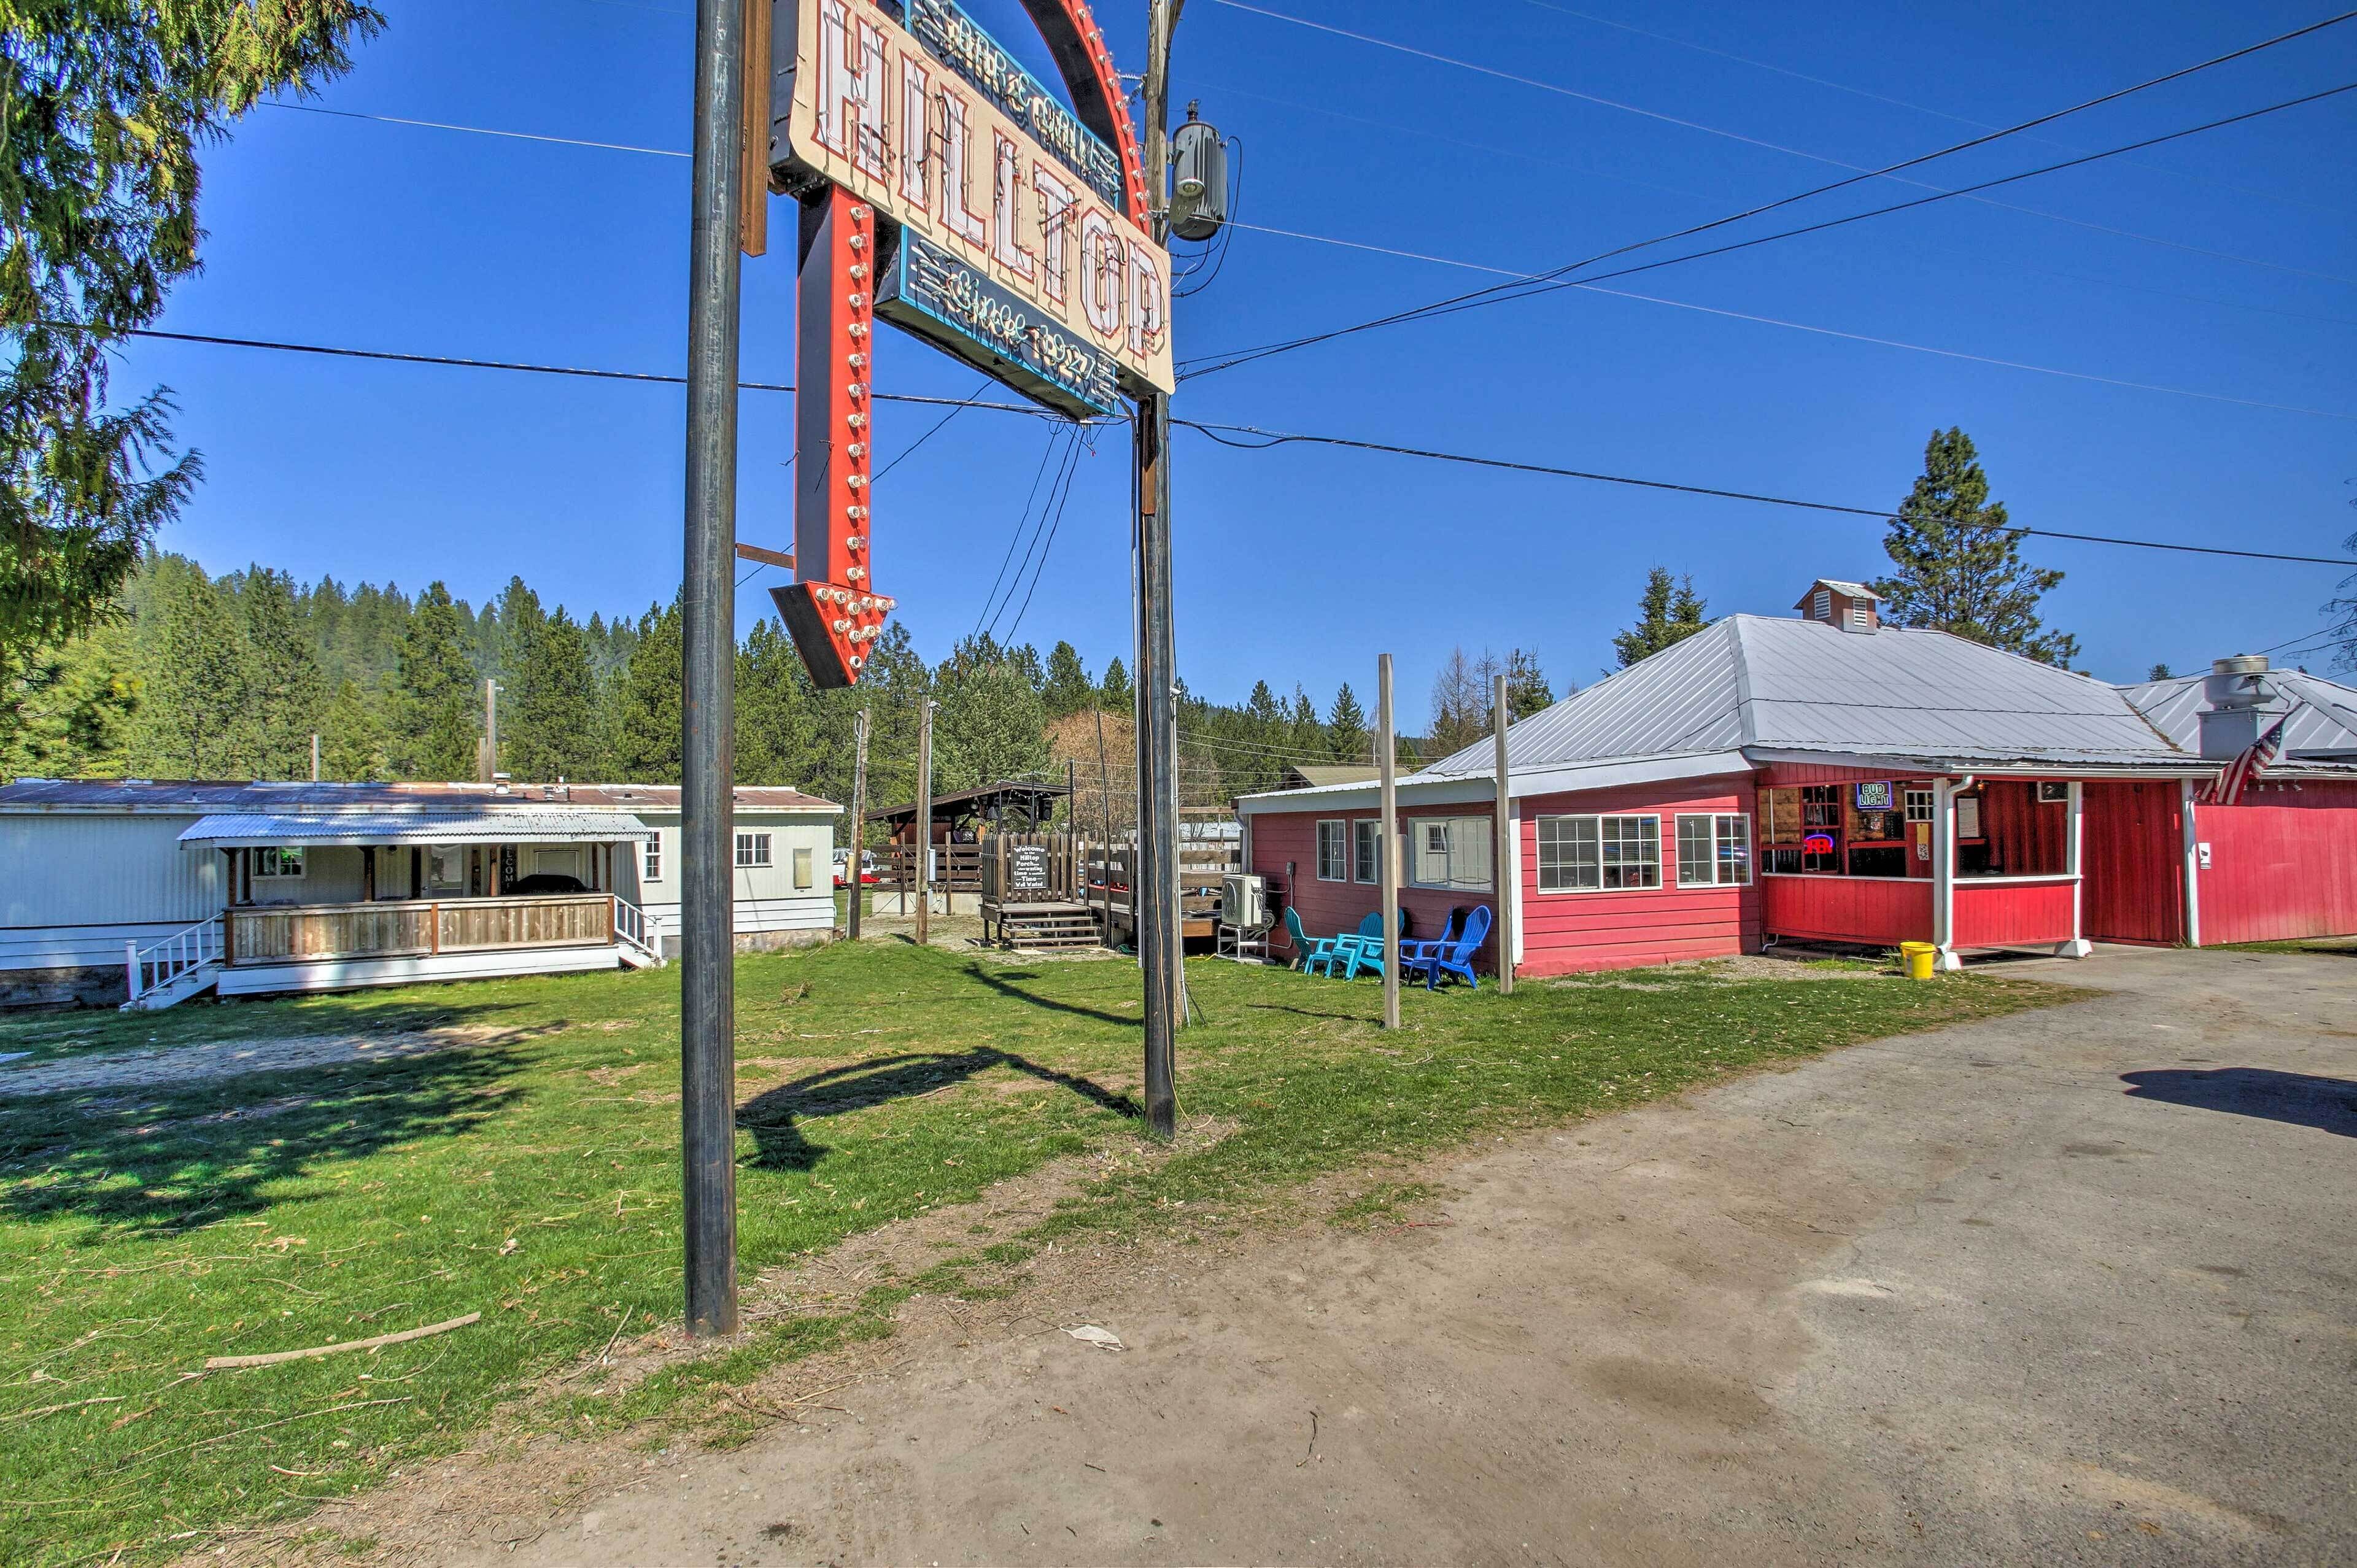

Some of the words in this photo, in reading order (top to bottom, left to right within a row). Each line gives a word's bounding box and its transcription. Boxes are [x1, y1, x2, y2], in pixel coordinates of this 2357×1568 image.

[811, 0, 1169, 360] HILLTOP
[946, 271, 1029, 344] Since
[1034, 325, 1096, 382] 1927
[1859, 794, 1889, 805] LIGHT
[1862, 784, 1884, 795] BUD
